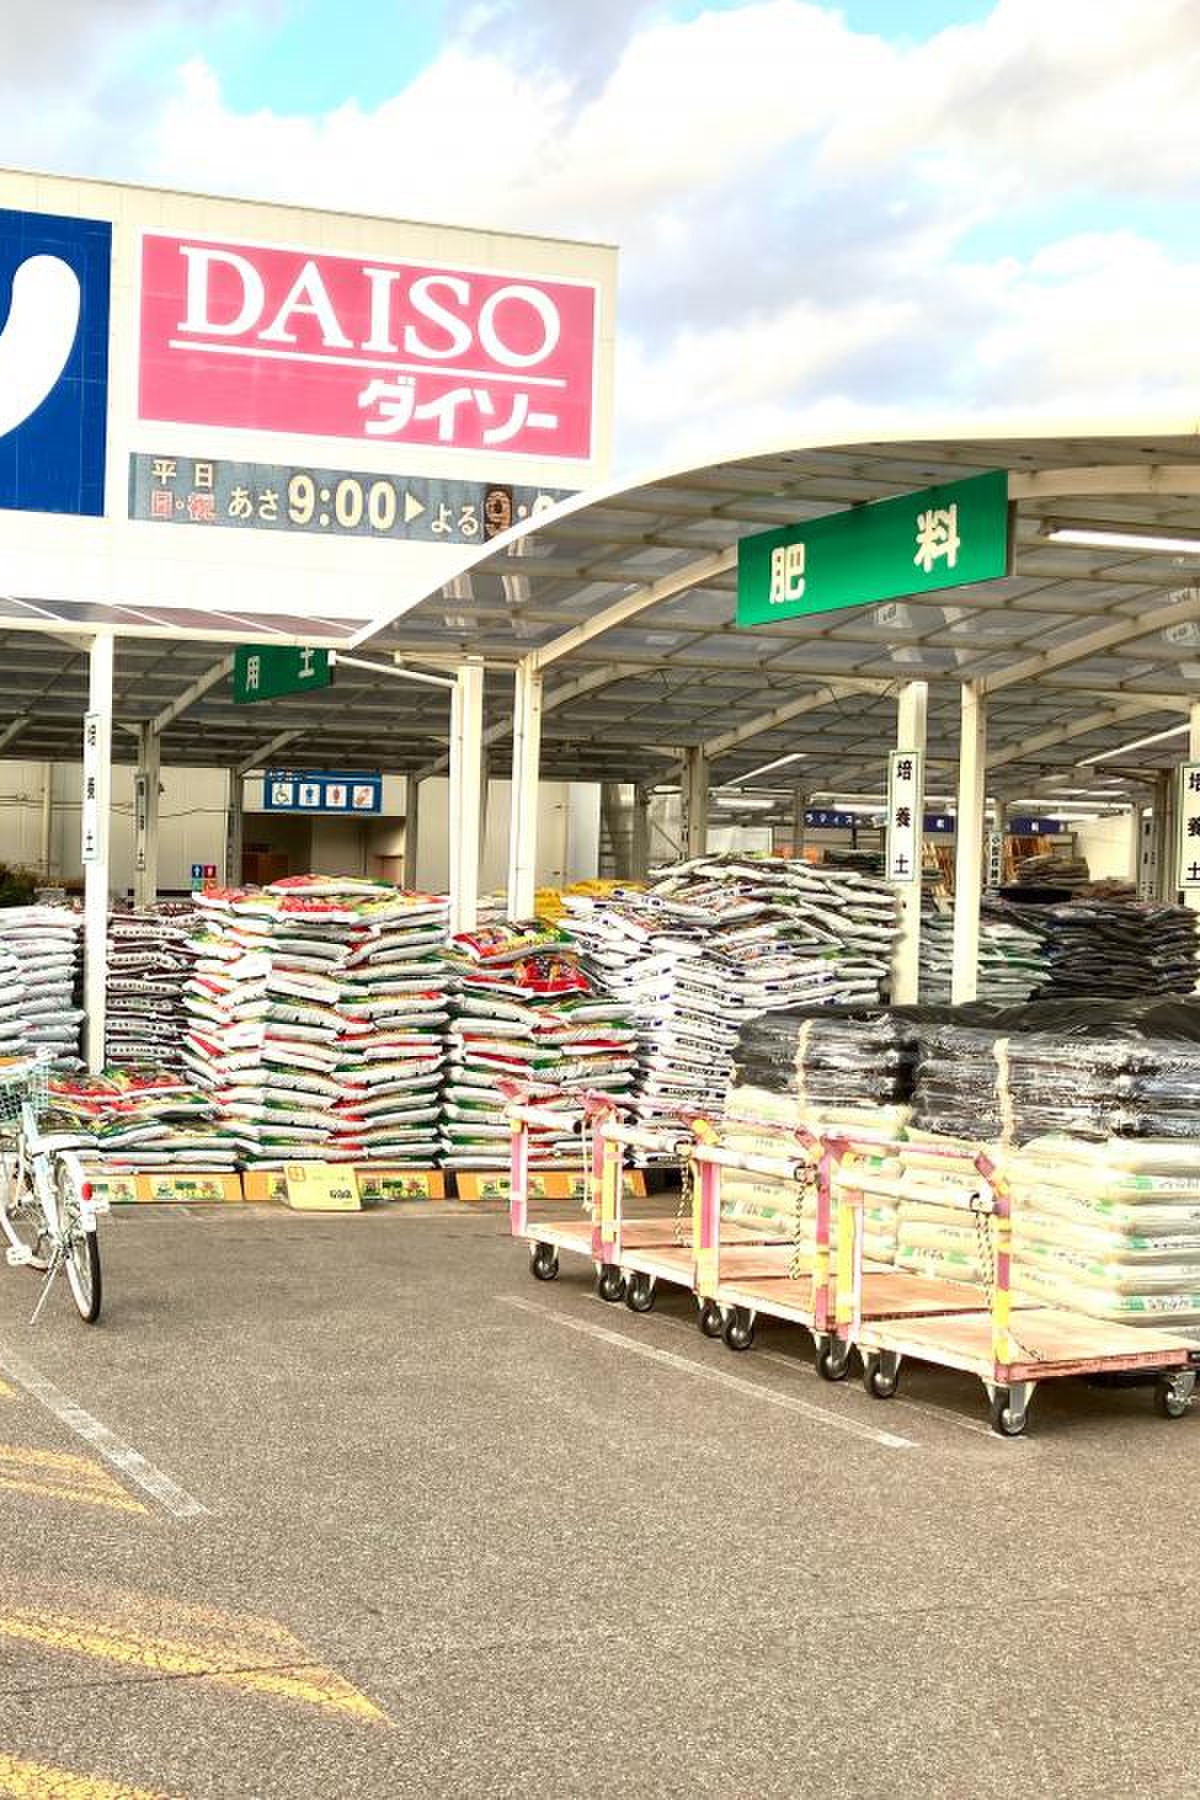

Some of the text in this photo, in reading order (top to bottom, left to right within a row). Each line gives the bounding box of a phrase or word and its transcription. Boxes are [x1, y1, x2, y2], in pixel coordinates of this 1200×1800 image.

[177, 245, 561, 367] DAISO
[358, 376, 559, 444] ダイソー
[152, 459, 213, 488] 平日
[769, 503, 960, 604] 肥料
